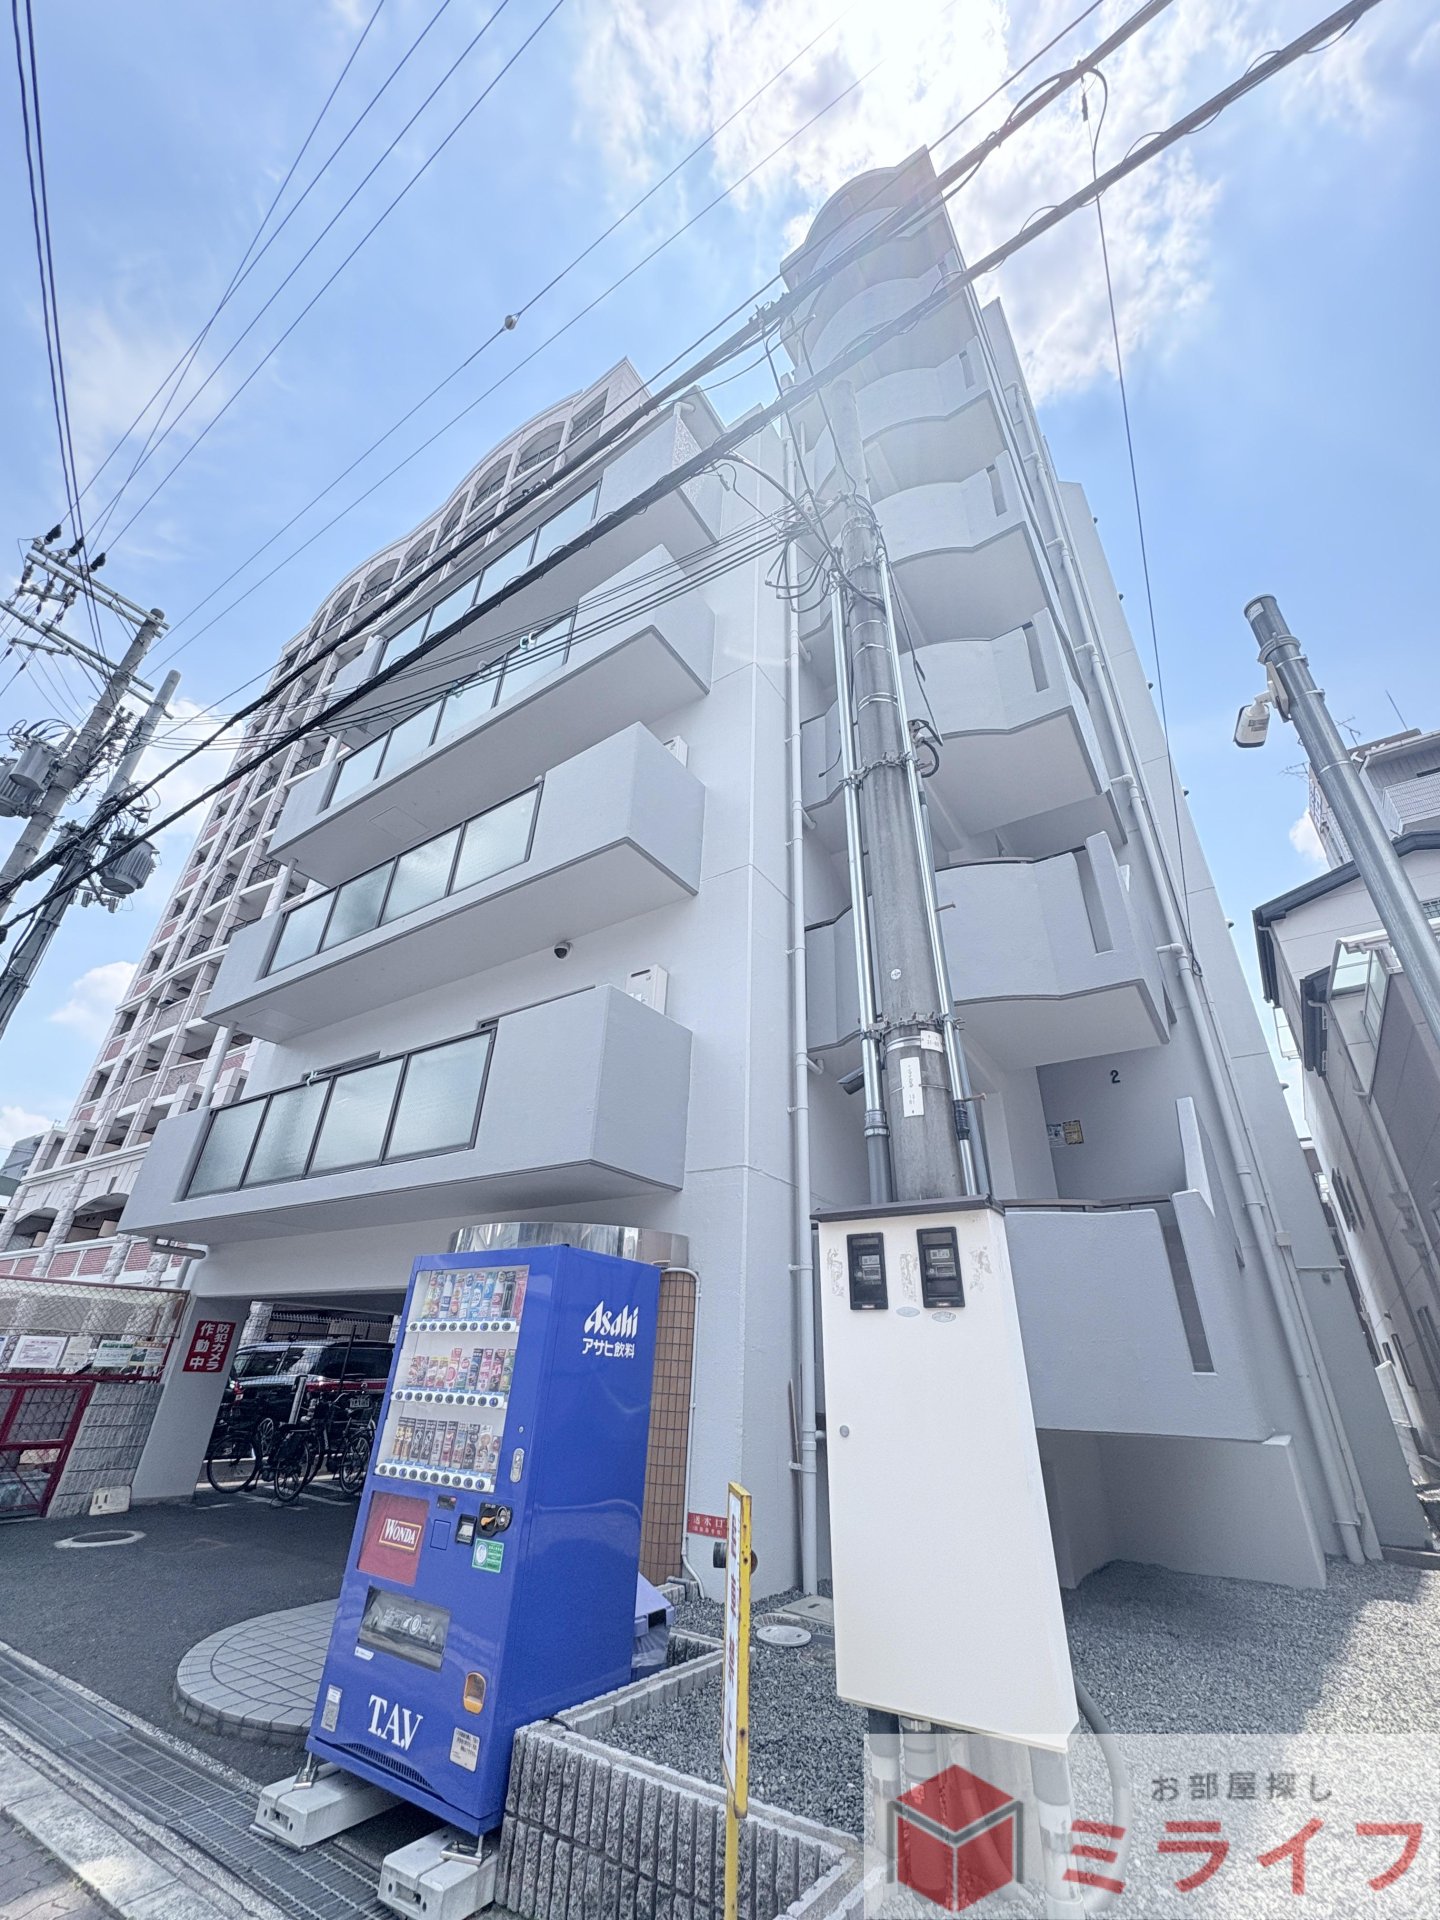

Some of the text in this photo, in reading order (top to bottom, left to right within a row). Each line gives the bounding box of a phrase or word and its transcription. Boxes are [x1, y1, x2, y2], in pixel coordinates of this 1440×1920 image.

[1110, 1069, 1121, 1084] 2
[584, 1300, 639, 1339] Asahi
[189, 1322, 216, 1370] 作動中
[205, 1323, 231, 1370] 防犯カメラ
[582, 1337, 635, 1359] アサヒ飲料
[384, 1518, 417, 1545] WONDA
